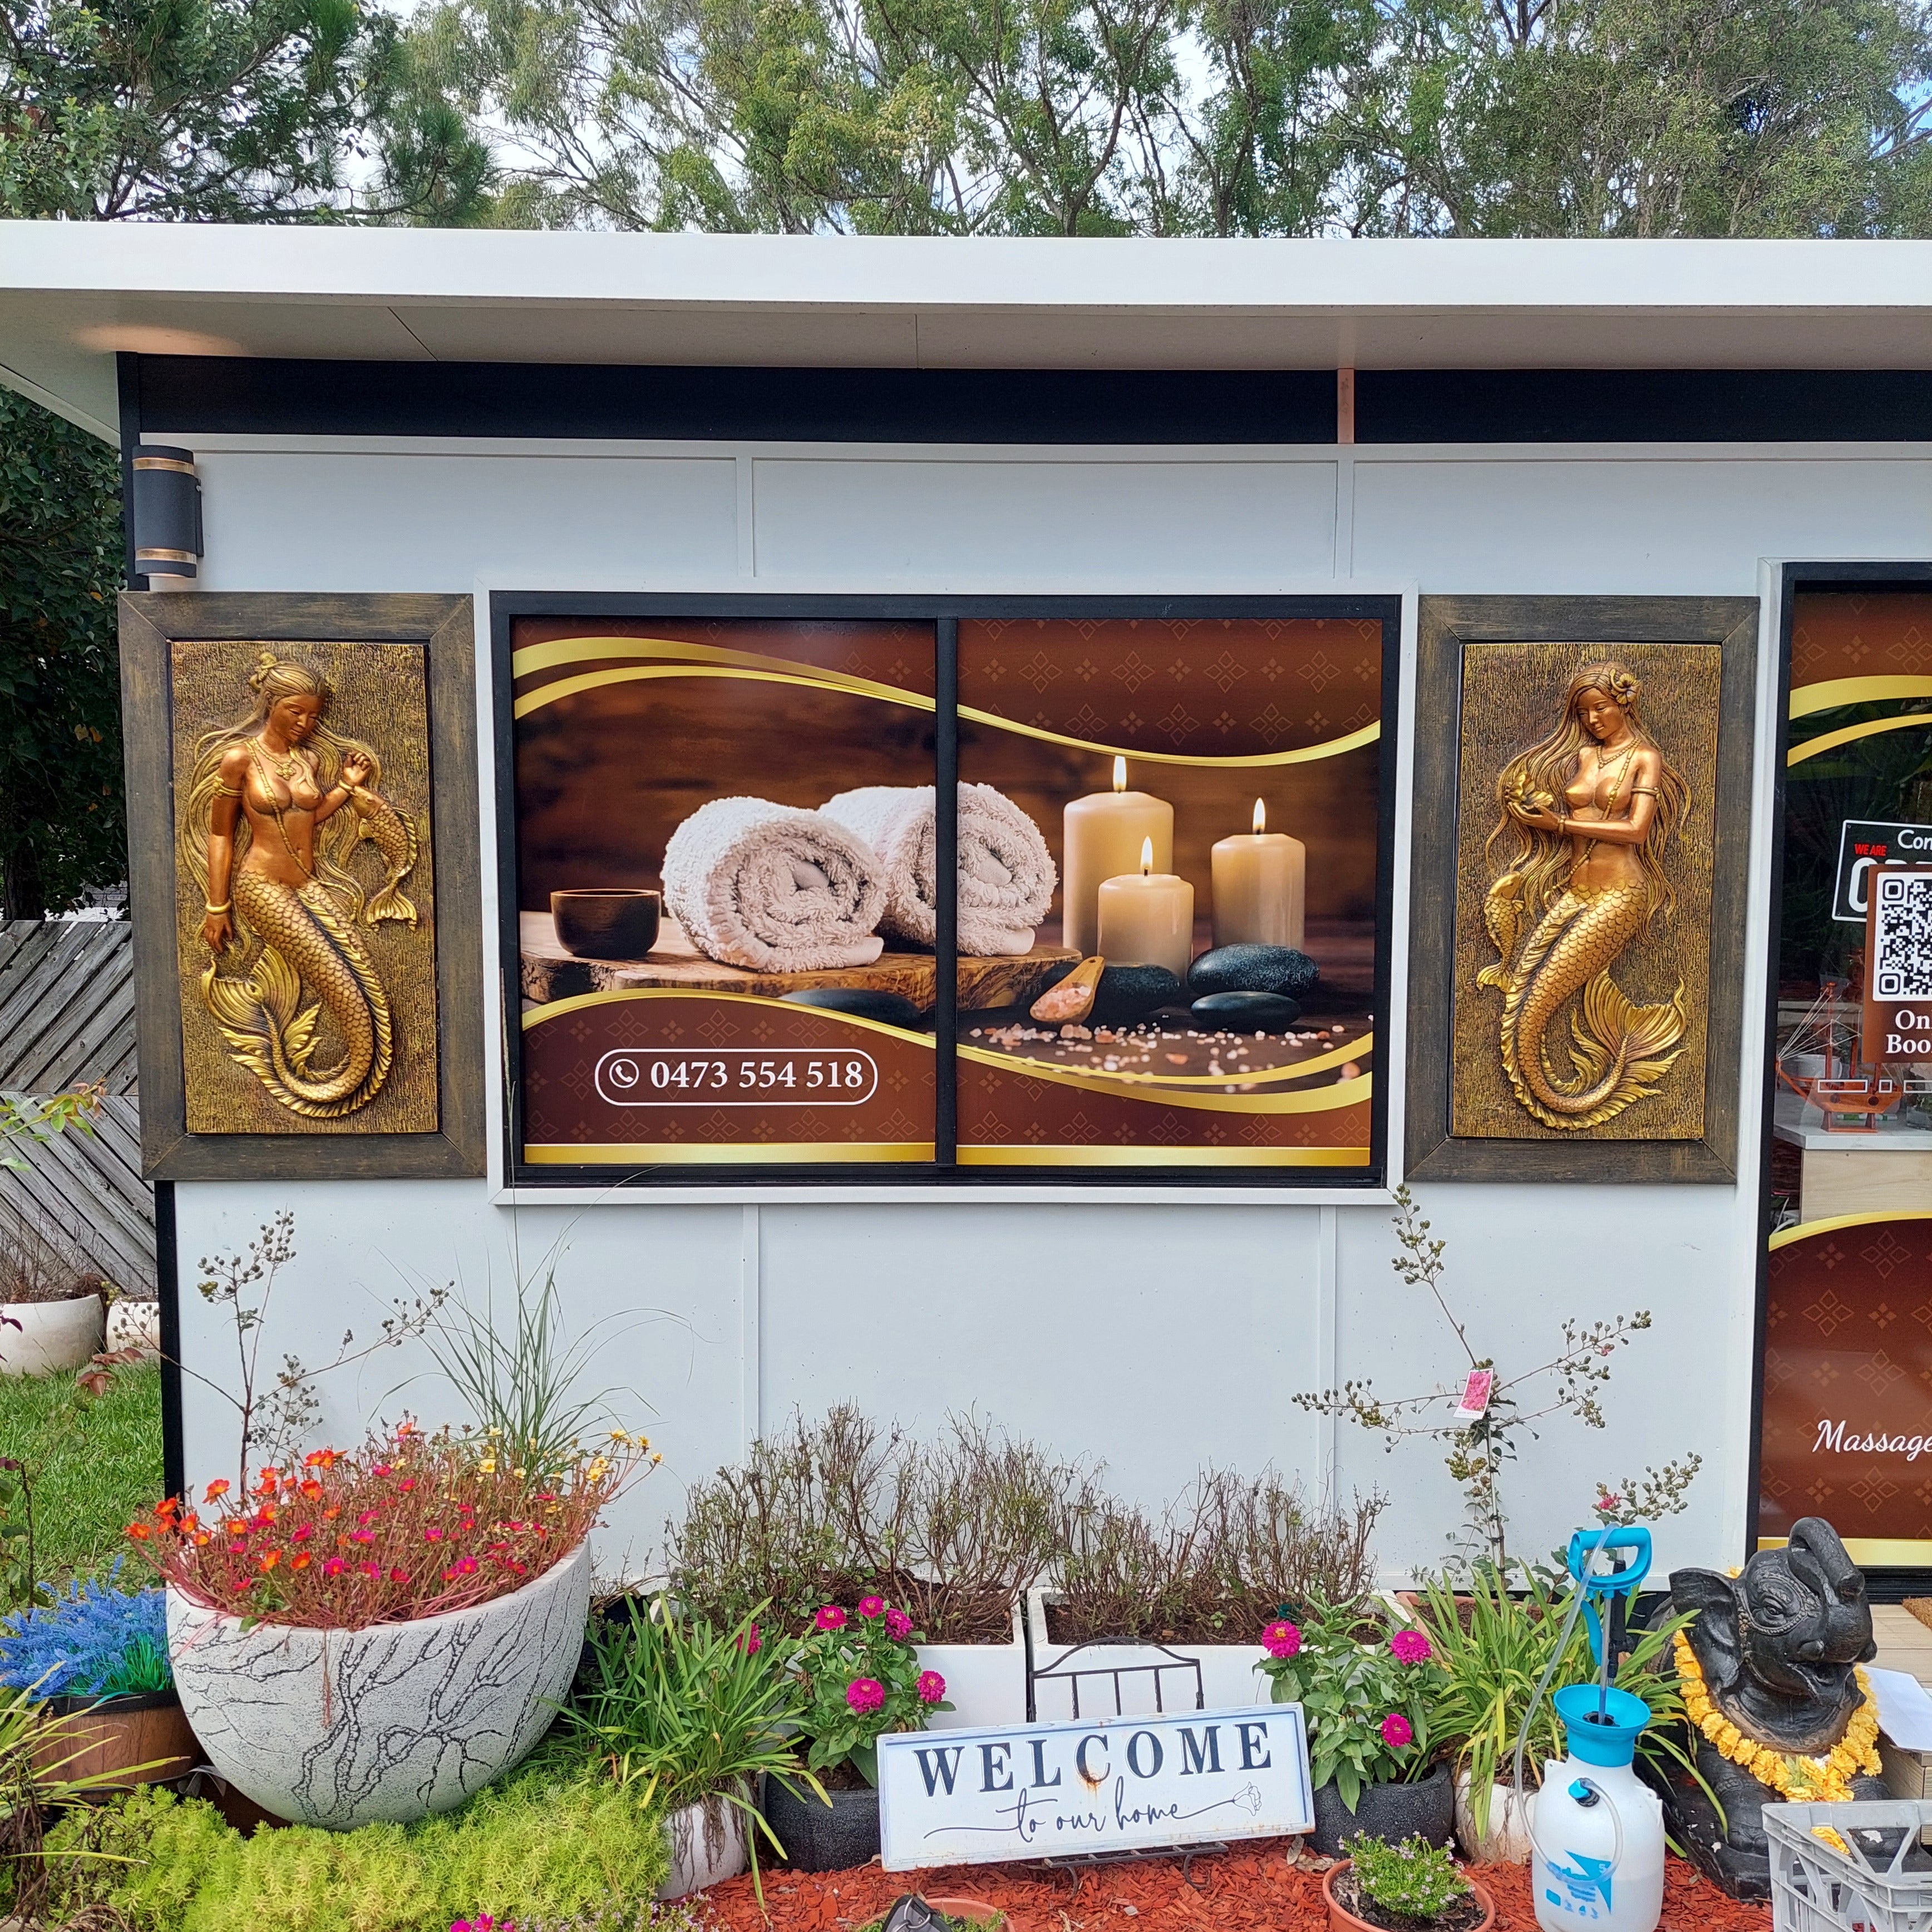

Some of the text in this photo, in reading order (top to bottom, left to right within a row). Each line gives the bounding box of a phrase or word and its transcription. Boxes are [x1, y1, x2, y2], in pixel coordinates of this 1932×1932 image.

[1854, 843, 1887, 856] WE ARE
[1895, 1009, 1932, 1030] On
[1885, 1034, 1932, 1053] Boo
[650, 1061, 863, 1088] 0473 554 518
[1812, 1420, 1932, 1461] Massage
[911, 1721, 1273, 1798] WELCOME
[1056, 1808, 1107, 1832] our
[1115, 1775, 1183, 1831] home
